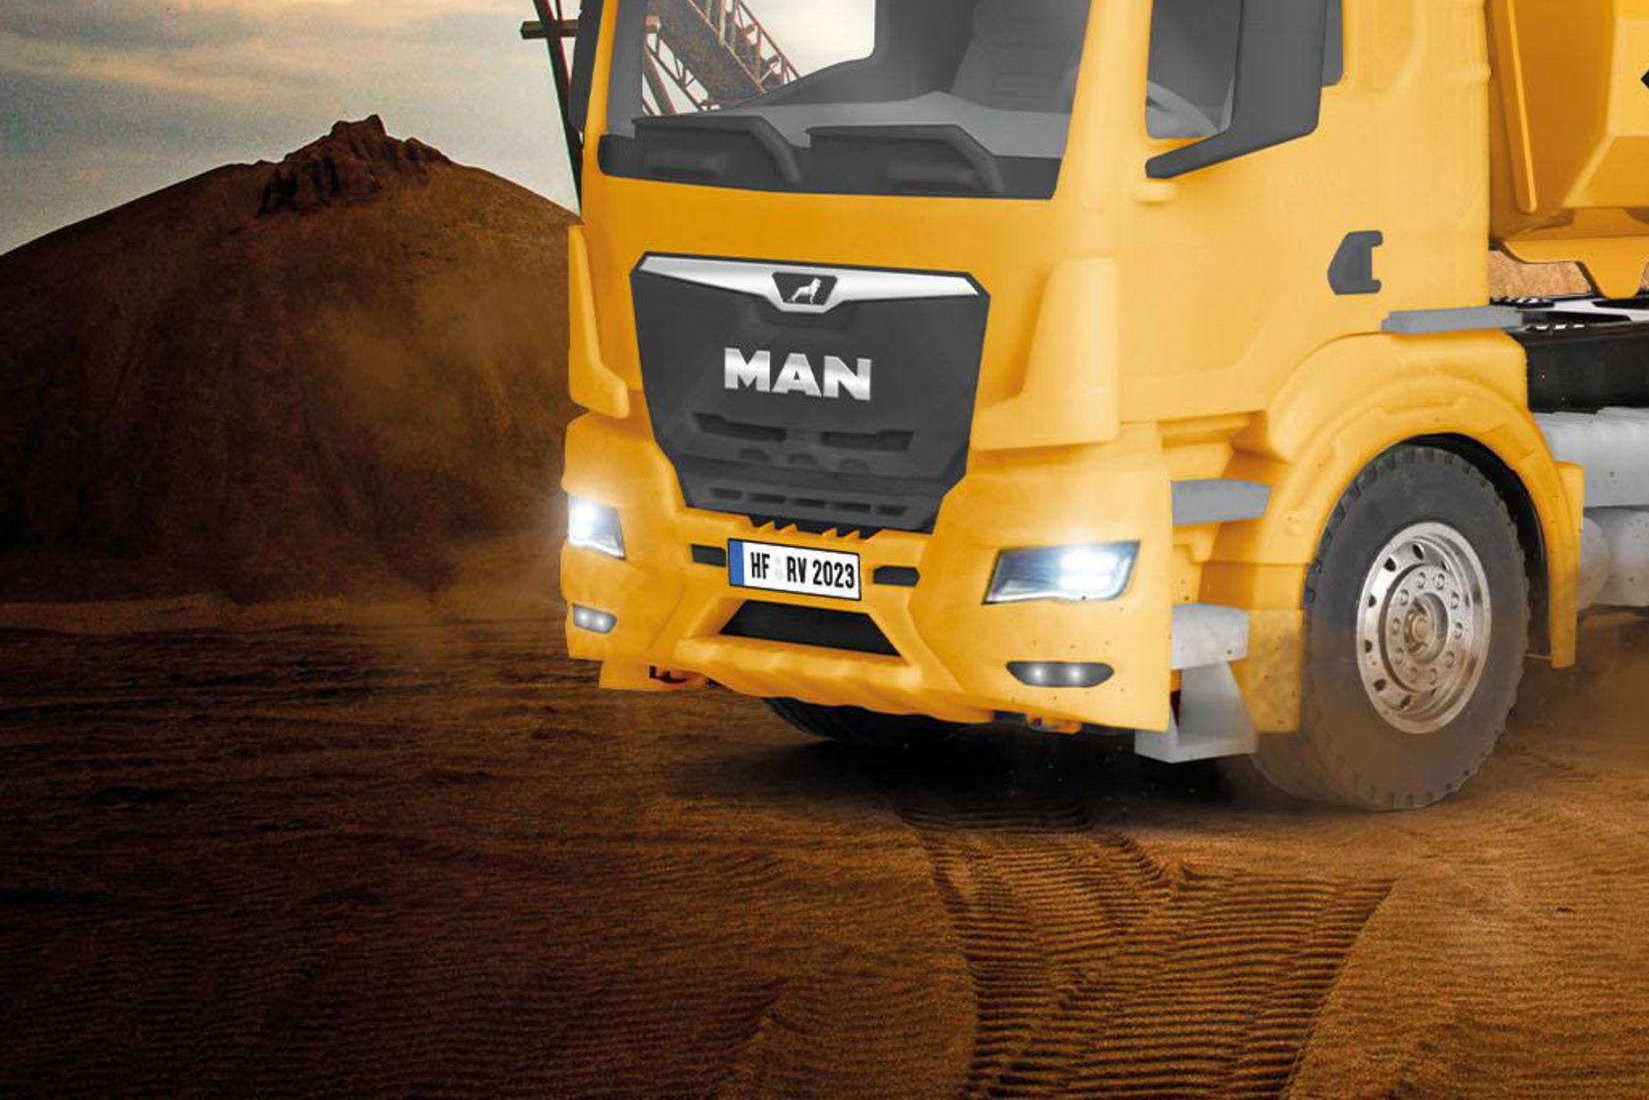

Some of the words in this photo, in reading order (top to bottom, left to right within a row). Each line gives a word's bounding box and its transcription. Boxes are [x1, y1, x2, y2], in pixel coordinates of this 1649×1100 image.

[724, 347, 872, 401] MAN
[750, 551, 771, 580] HF
[786, 556, 808, 584] RV
[812, 559, 856, 589] 2023
